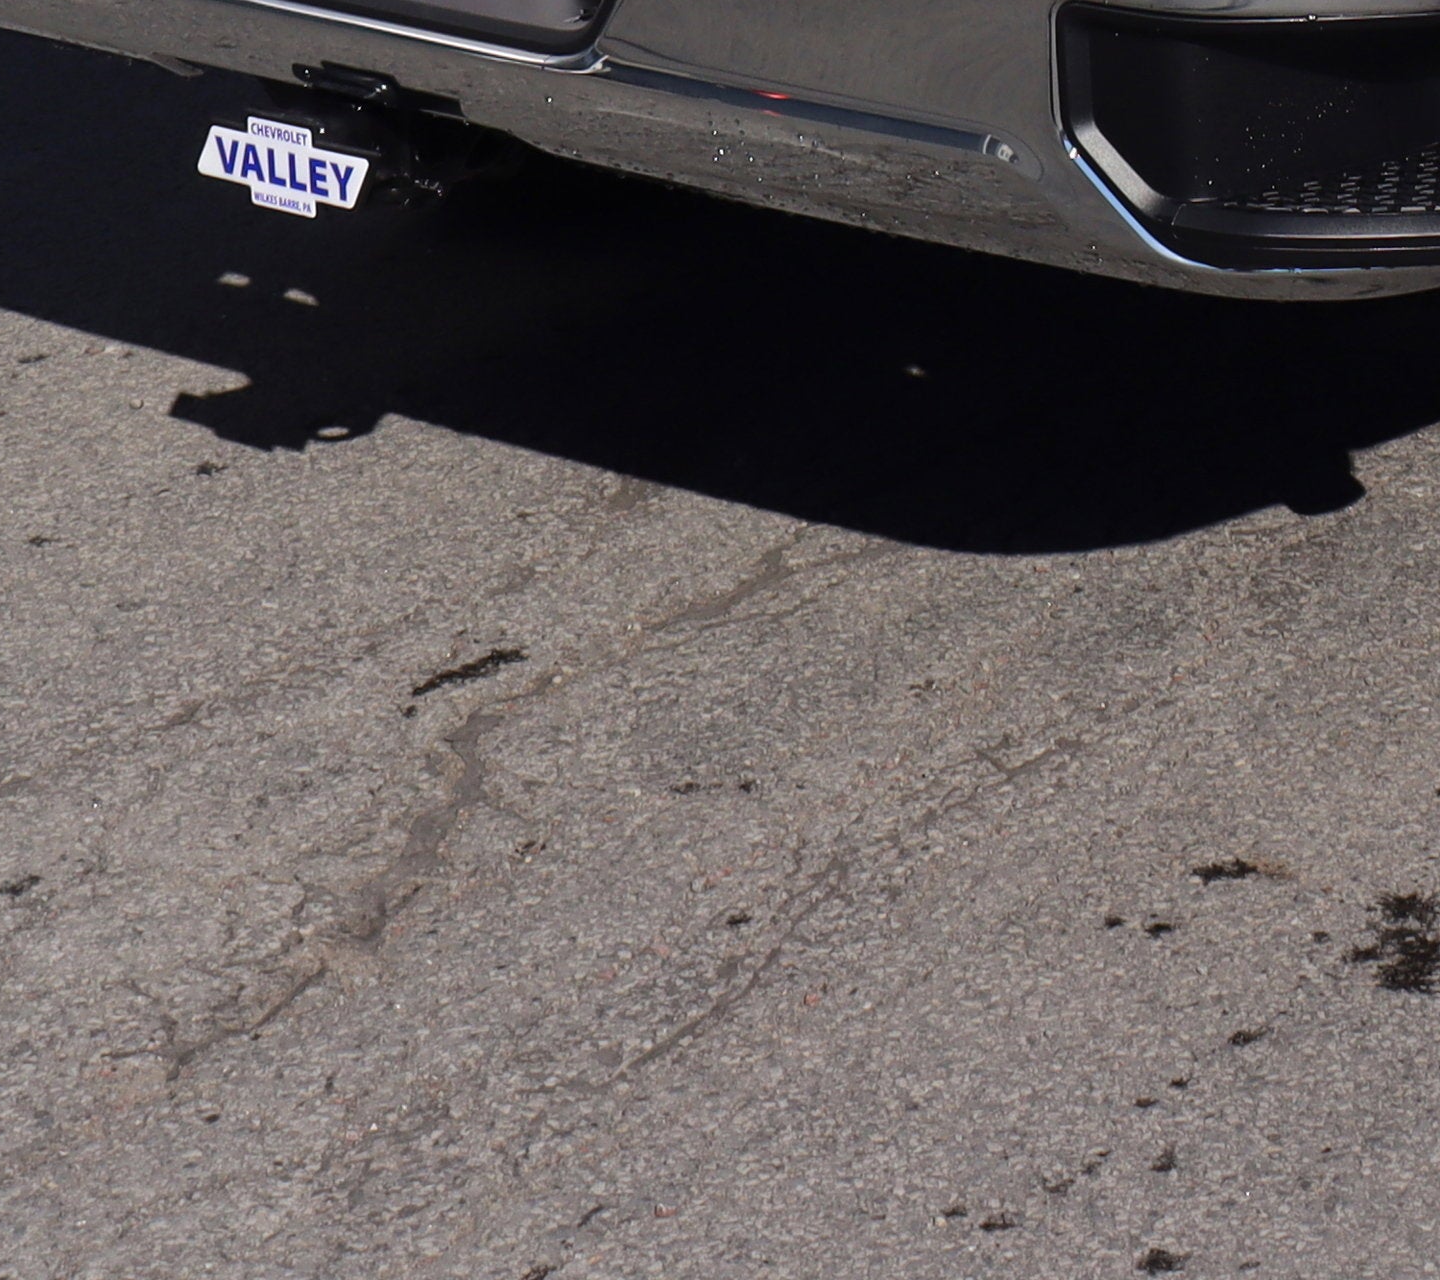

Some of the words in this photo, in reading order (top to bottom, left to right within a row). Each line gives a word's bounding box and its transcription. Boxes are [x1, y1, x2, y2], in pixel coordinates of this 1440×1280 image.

[250, 122, 308, 146] CHEVROLET
[215, 135, 354, 202] VALLEY
[254, 191, 277, 205] WILKES
[303, 202, 312, 213] PA
